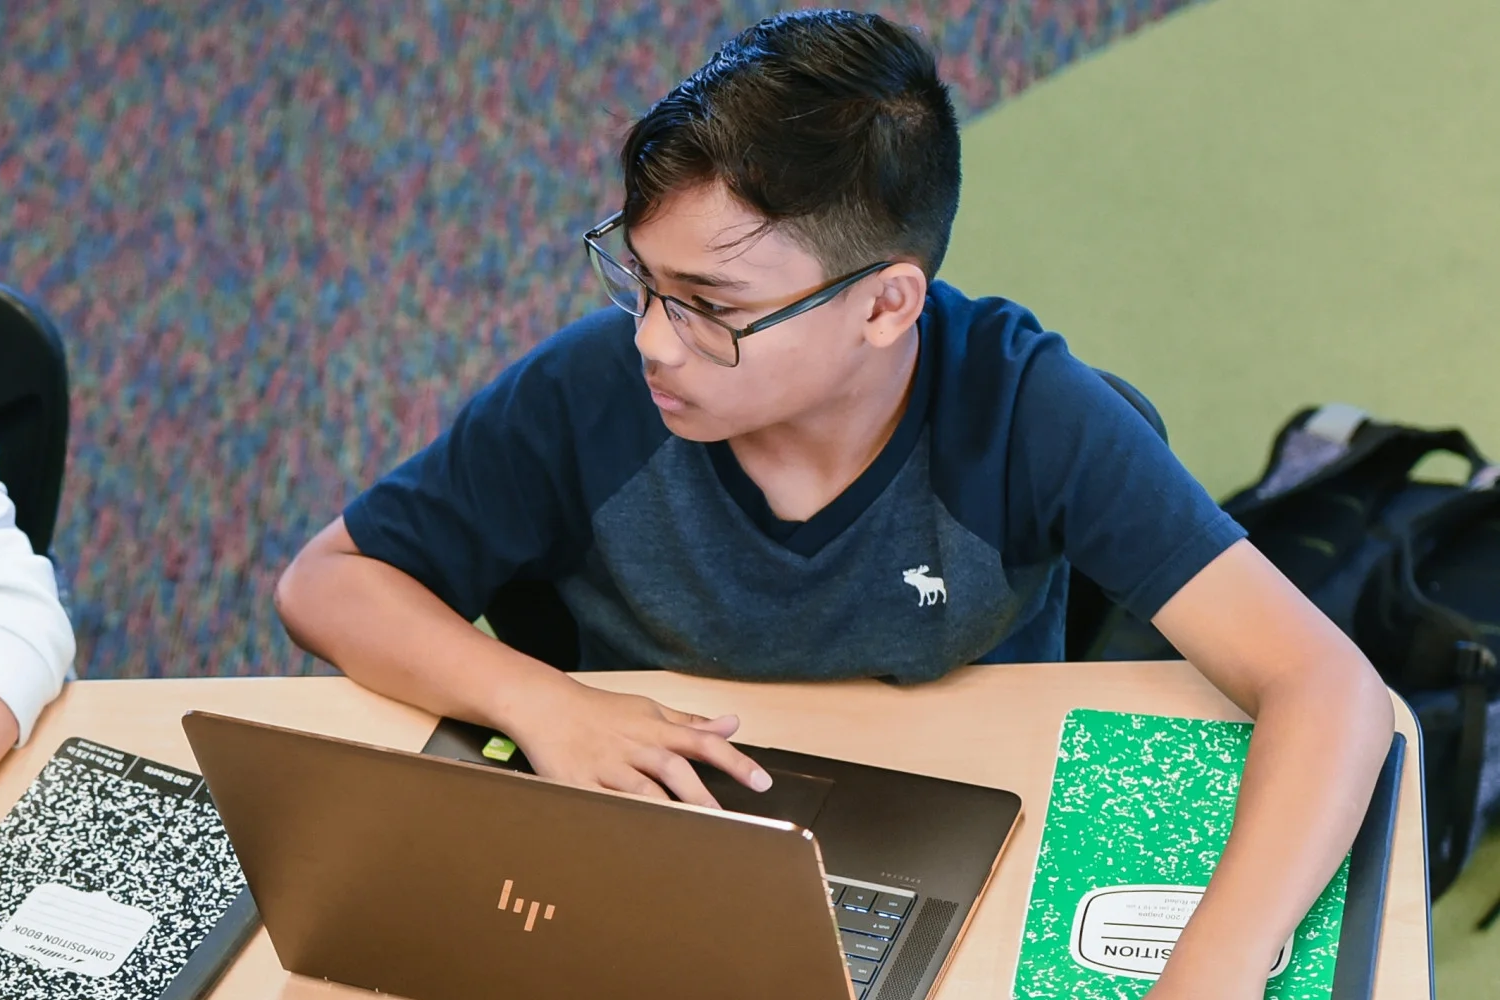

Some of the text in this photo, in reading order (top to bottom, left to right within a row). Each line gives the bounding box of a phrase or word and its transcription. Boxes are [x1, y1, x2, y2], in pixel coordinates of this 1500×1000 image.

[11, 924, 116, 962] COMPOSITION BOOK
[1104, 945, 1173, 960] SITION
